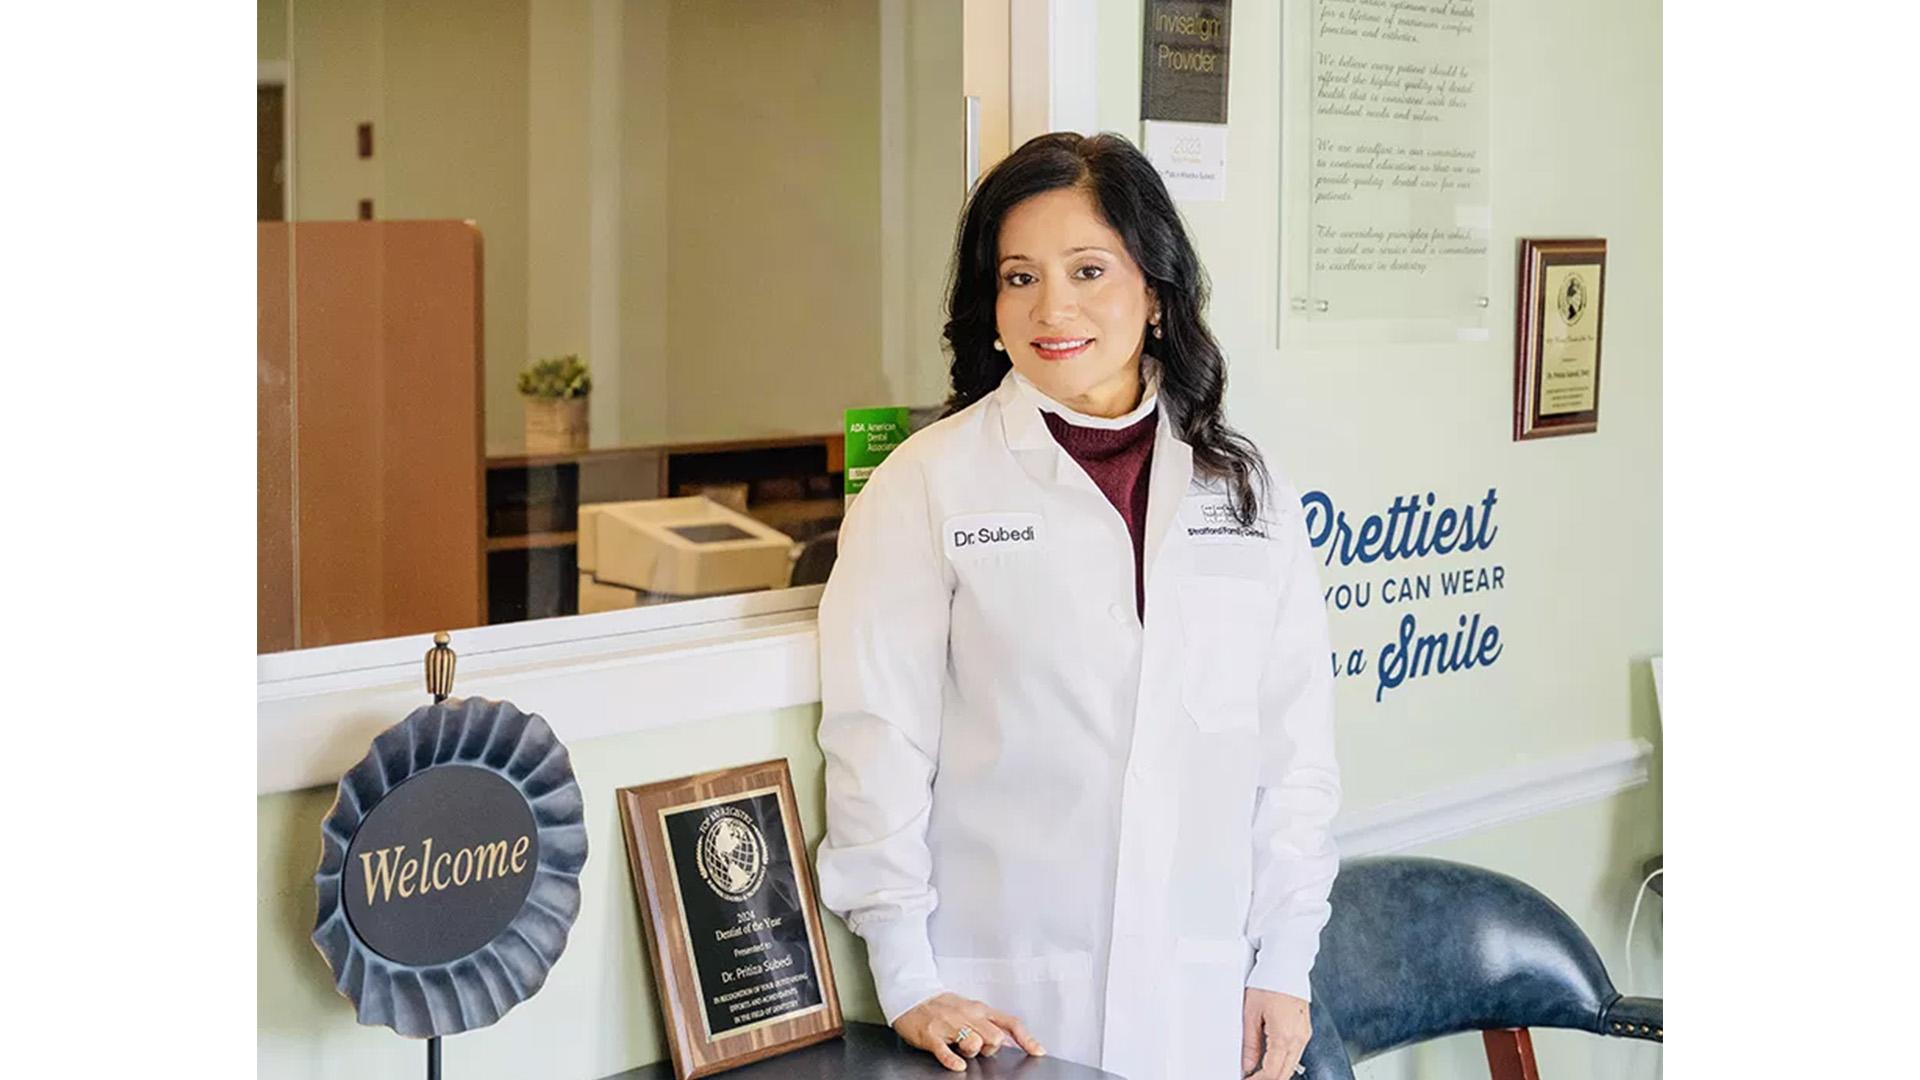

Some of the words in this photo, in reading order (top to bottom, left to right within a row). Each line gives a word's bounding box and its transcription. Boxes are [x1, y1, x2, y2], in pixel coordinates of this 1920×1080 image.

[1158, 43, 1217, 72] Provider
[1317, 52, 1335, 65] We
[1316, 138, 1334, 151] We
[868, 422, 896, 431] American
[954, 531, 975, 547] Dr.
[978, 526, 1034, 543] Subedi
[1301, 488, 1498, 567] Prettiest
[1382, 577, 1431, 604] CAN
[1441, 566, 1505, 596] WEAR
[1347, 649, 1367, 676] a
[1376, 613, 1503, 702] Smile
[359, 835, 530, 906] Welcome
[715, 925, 743, 941] Dentist
[743, 922, 752, 933] of
[752, 920, 765, 932] the
[763, 917, 782, 929] Year
[733, 943, 764, 958] Presented
[764, 941, 772, 950] to
[721, 971, 735, 983] Dr.
[763, 954, 793, 972] Subedi
